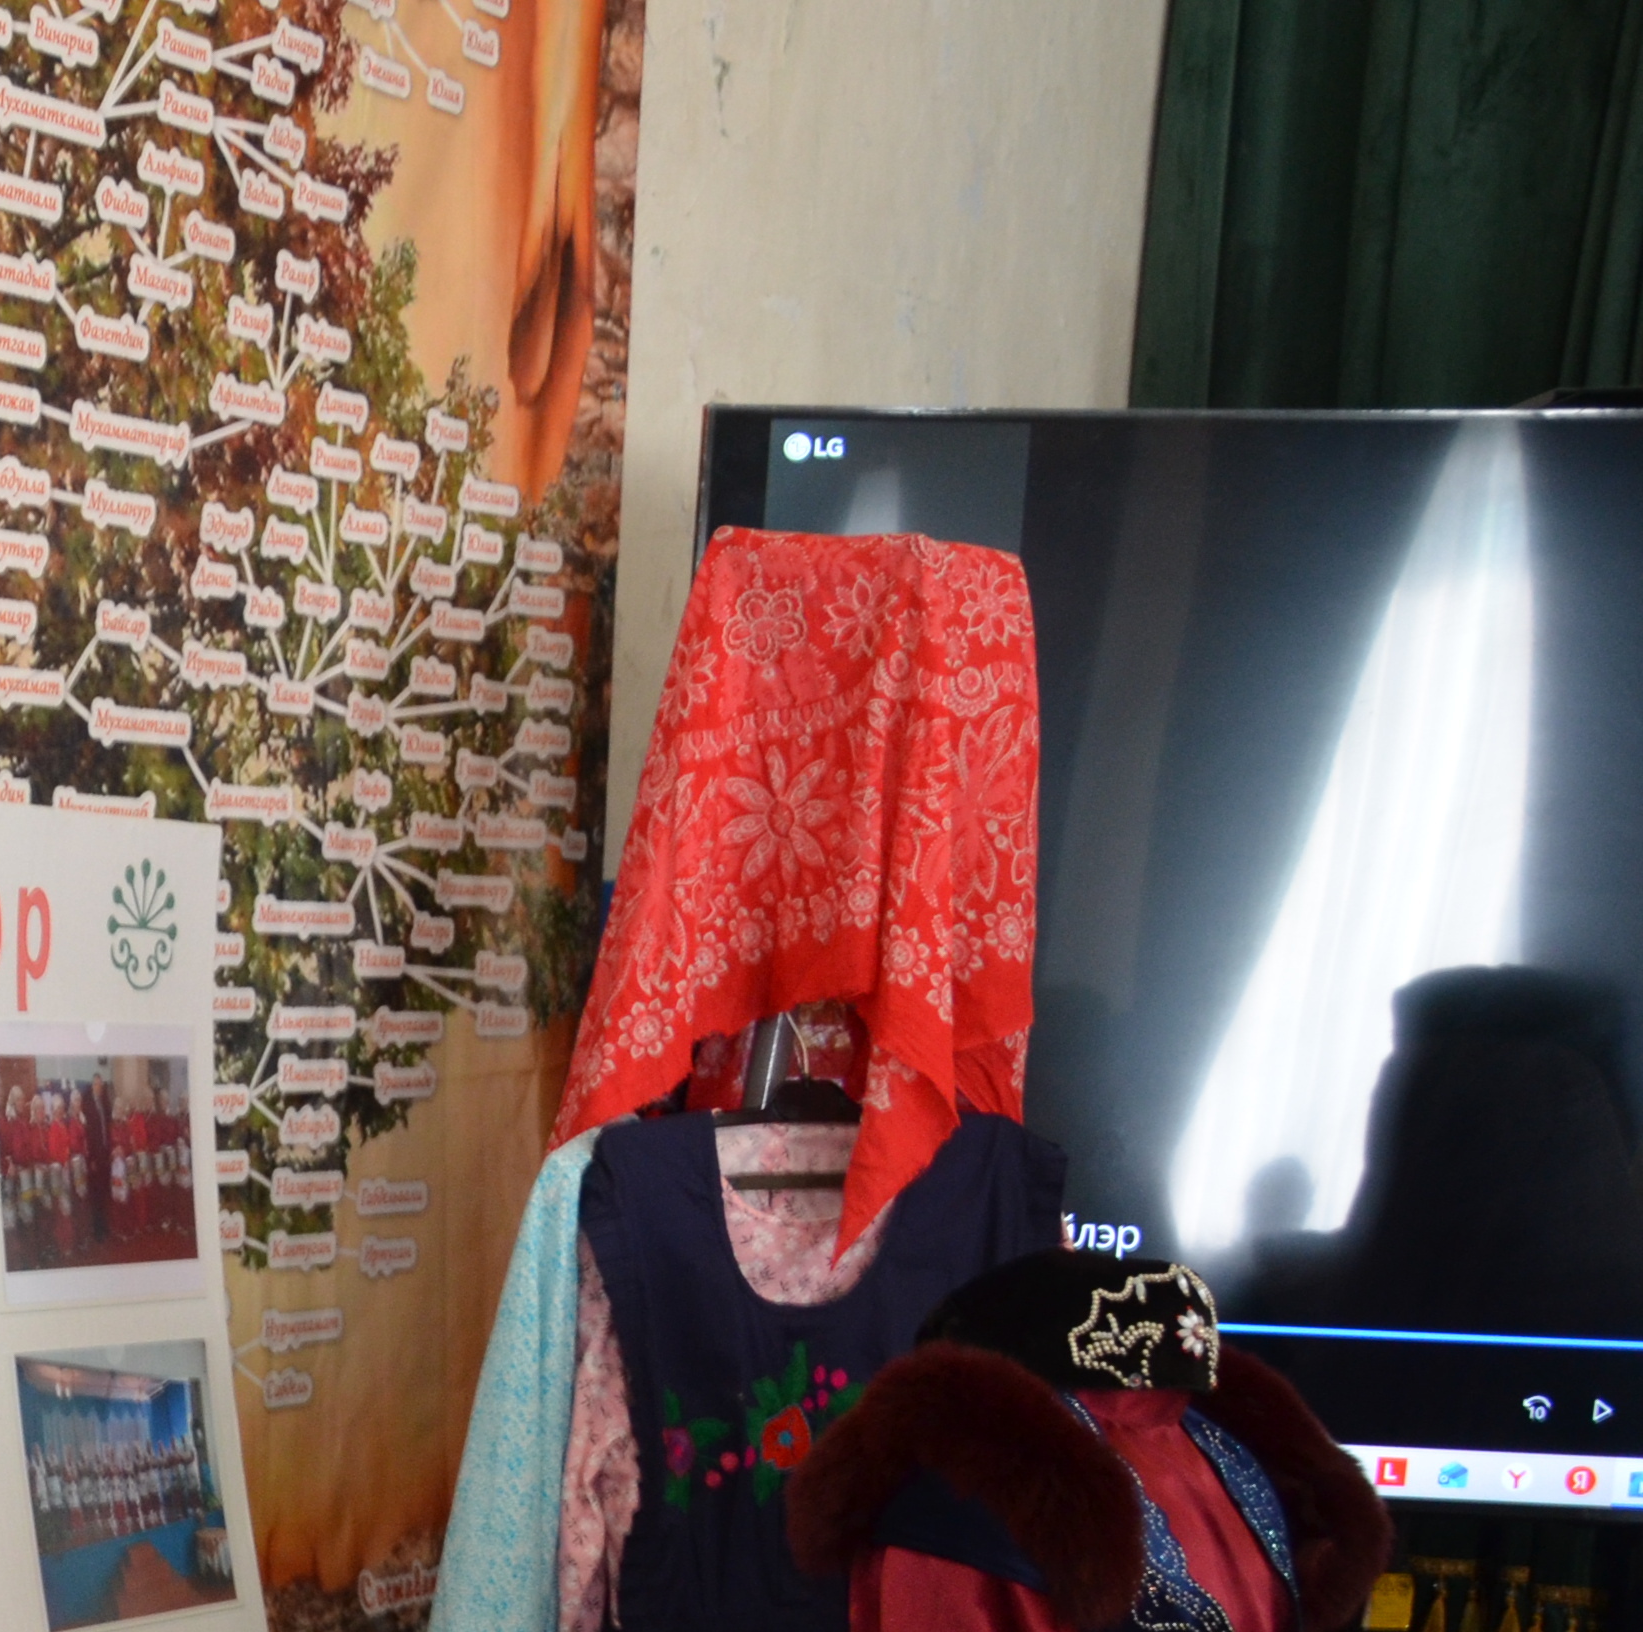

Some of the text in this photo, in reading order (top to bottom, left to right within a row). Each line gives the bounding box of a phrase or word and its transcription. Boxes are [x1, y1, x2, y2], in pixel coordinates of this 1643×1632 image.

[34, 18, 95, 54] Винария
[162, 30, 207, 61] Рашит
[163, 92, 209, 123] Рамзия
[101, 187, 144, 218] Фидан
[813, 437, 845, 459] LG
[87, 491, 152, 525] Мулланур
[205, 515, 250, 541] Эдуард
